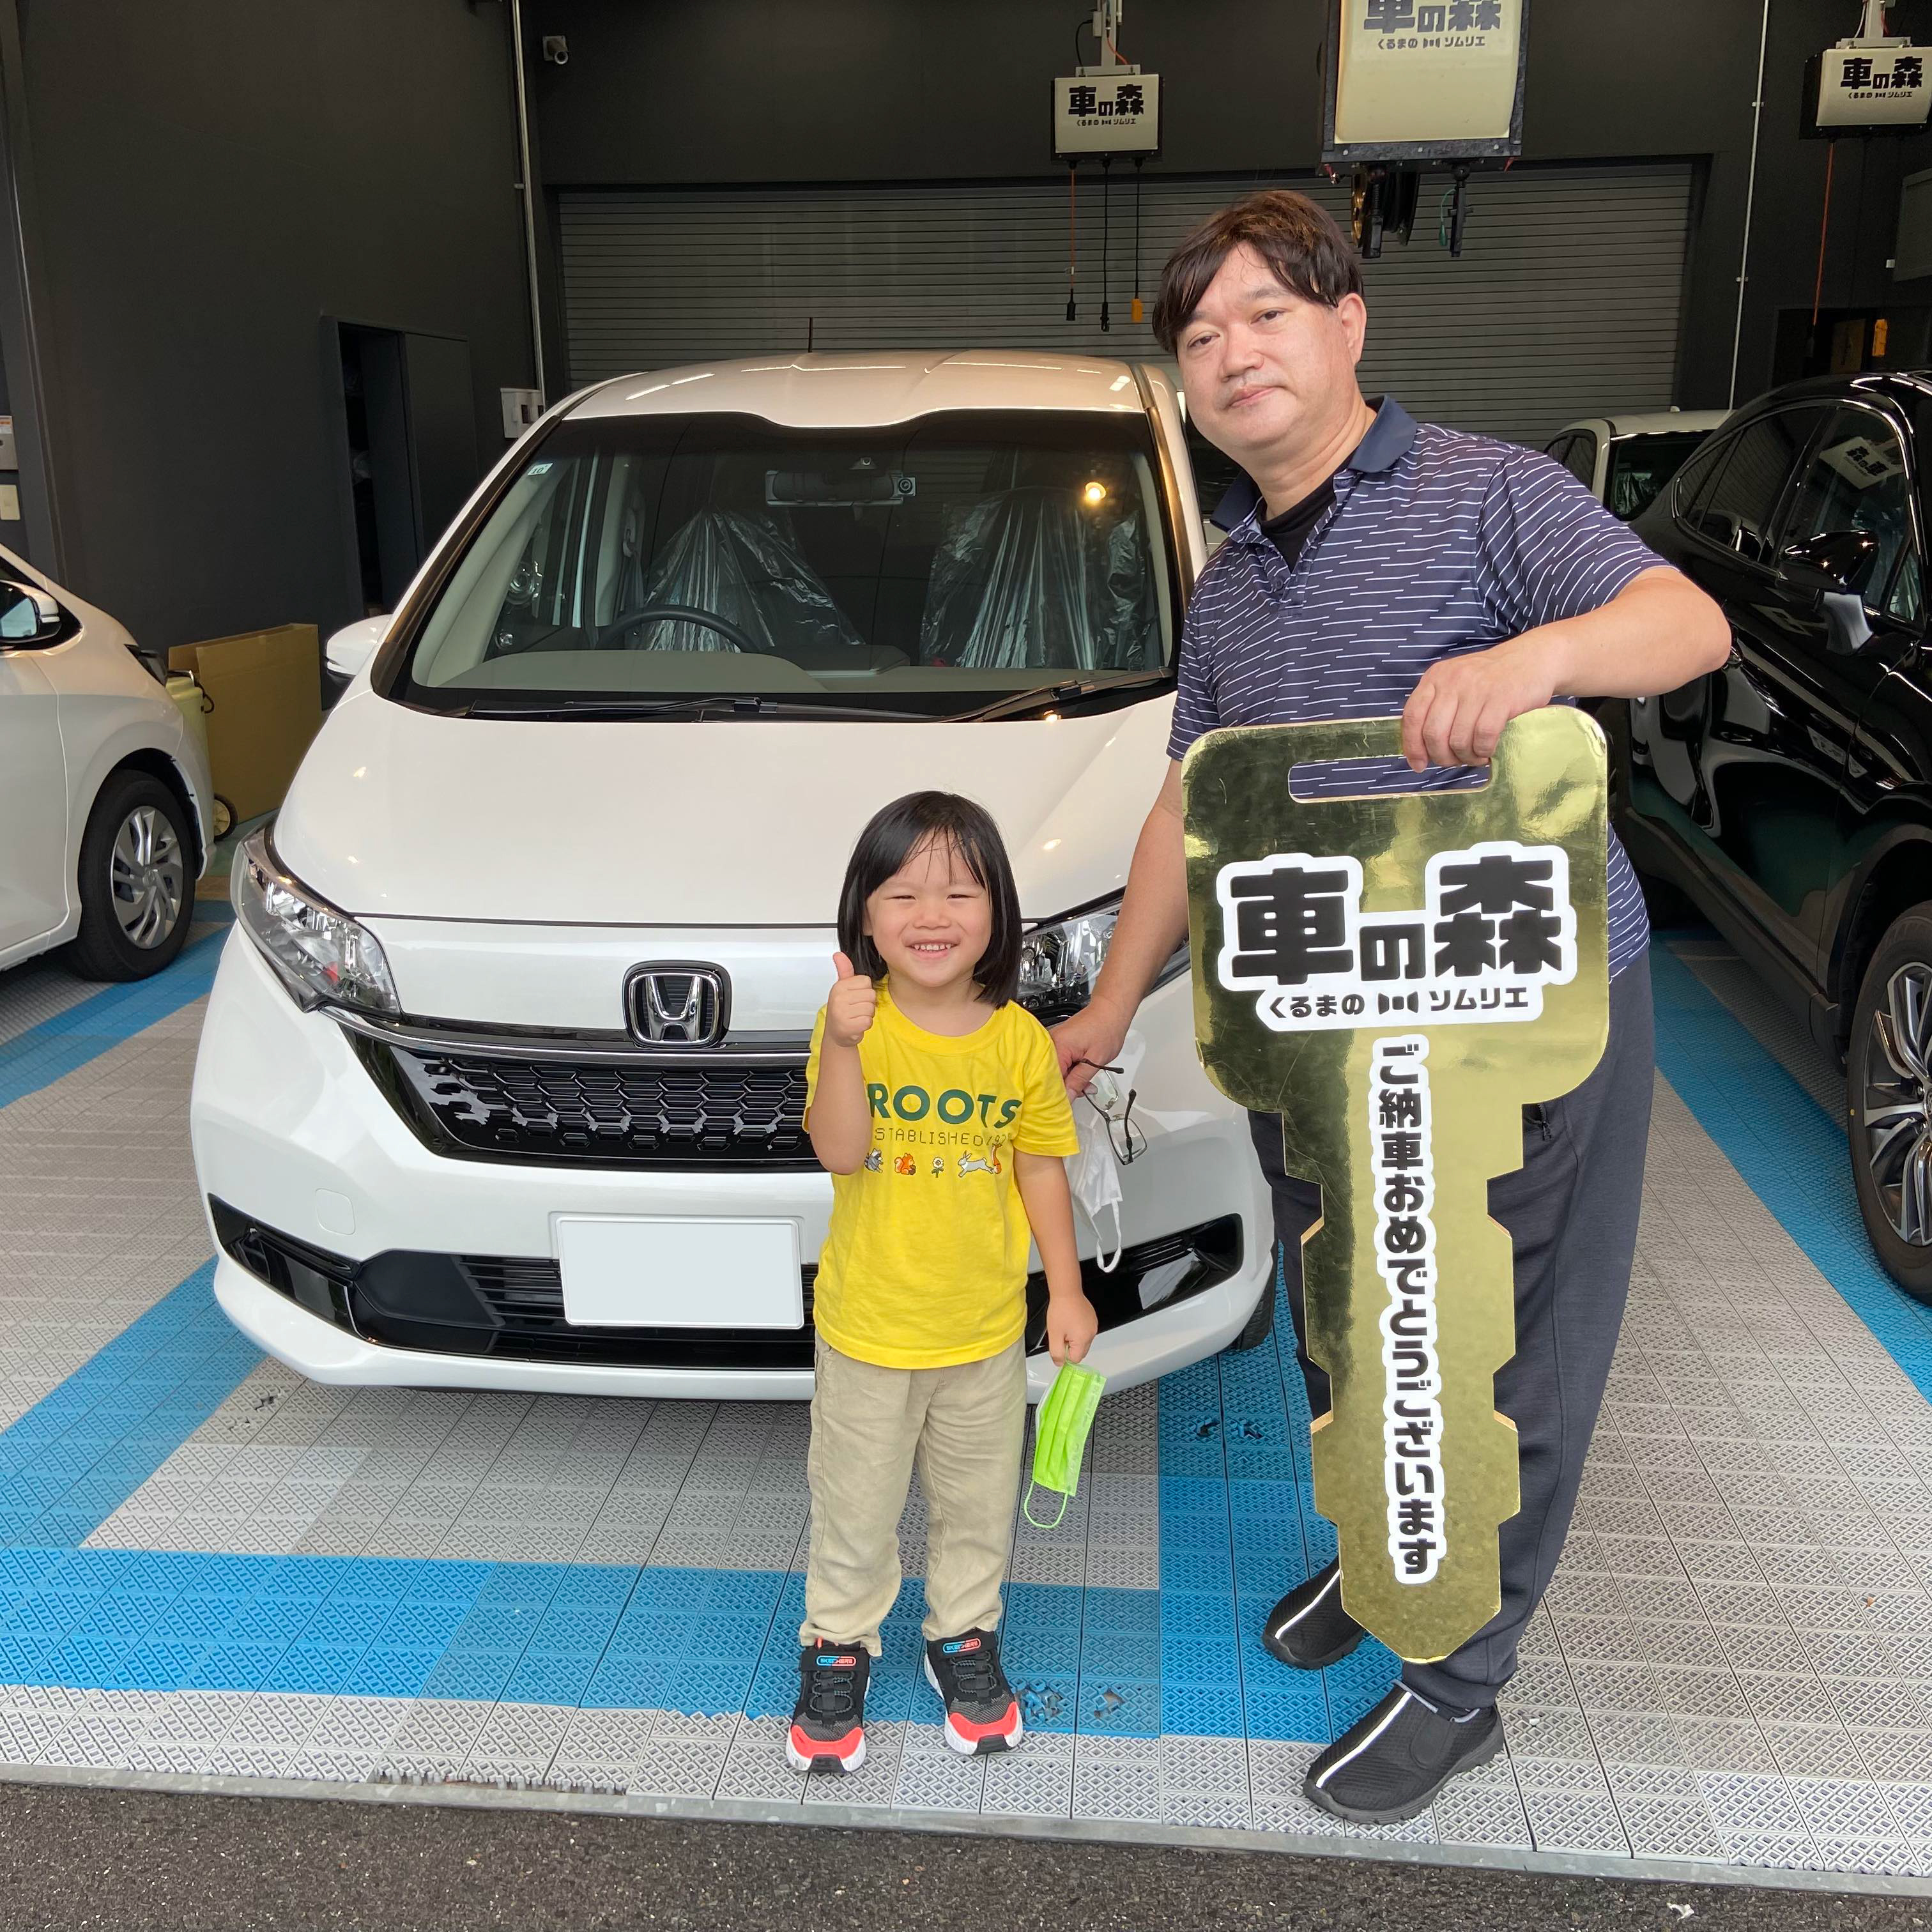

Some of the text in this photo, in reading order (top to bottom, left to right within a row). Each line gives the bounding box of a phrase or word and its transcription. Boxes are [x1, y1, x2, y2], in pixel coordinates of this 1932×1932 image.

[1377, 36, 1485, 50] くるまの ソムリエ
[1841, 56, 1923, 89] 車の森
[1068, 84, 1144, 117] 車の森
[1230, 854, 1561, 985] 車の森
[1269, 986, 1529, 1018] くるまの ソムリエ
[867, 1083, 1022, 1129] ROOTS
[874, 1128, 983, 1146] STABLISHED
[1378, 1043, 1437, 1575] ご納車おめでとうございます
